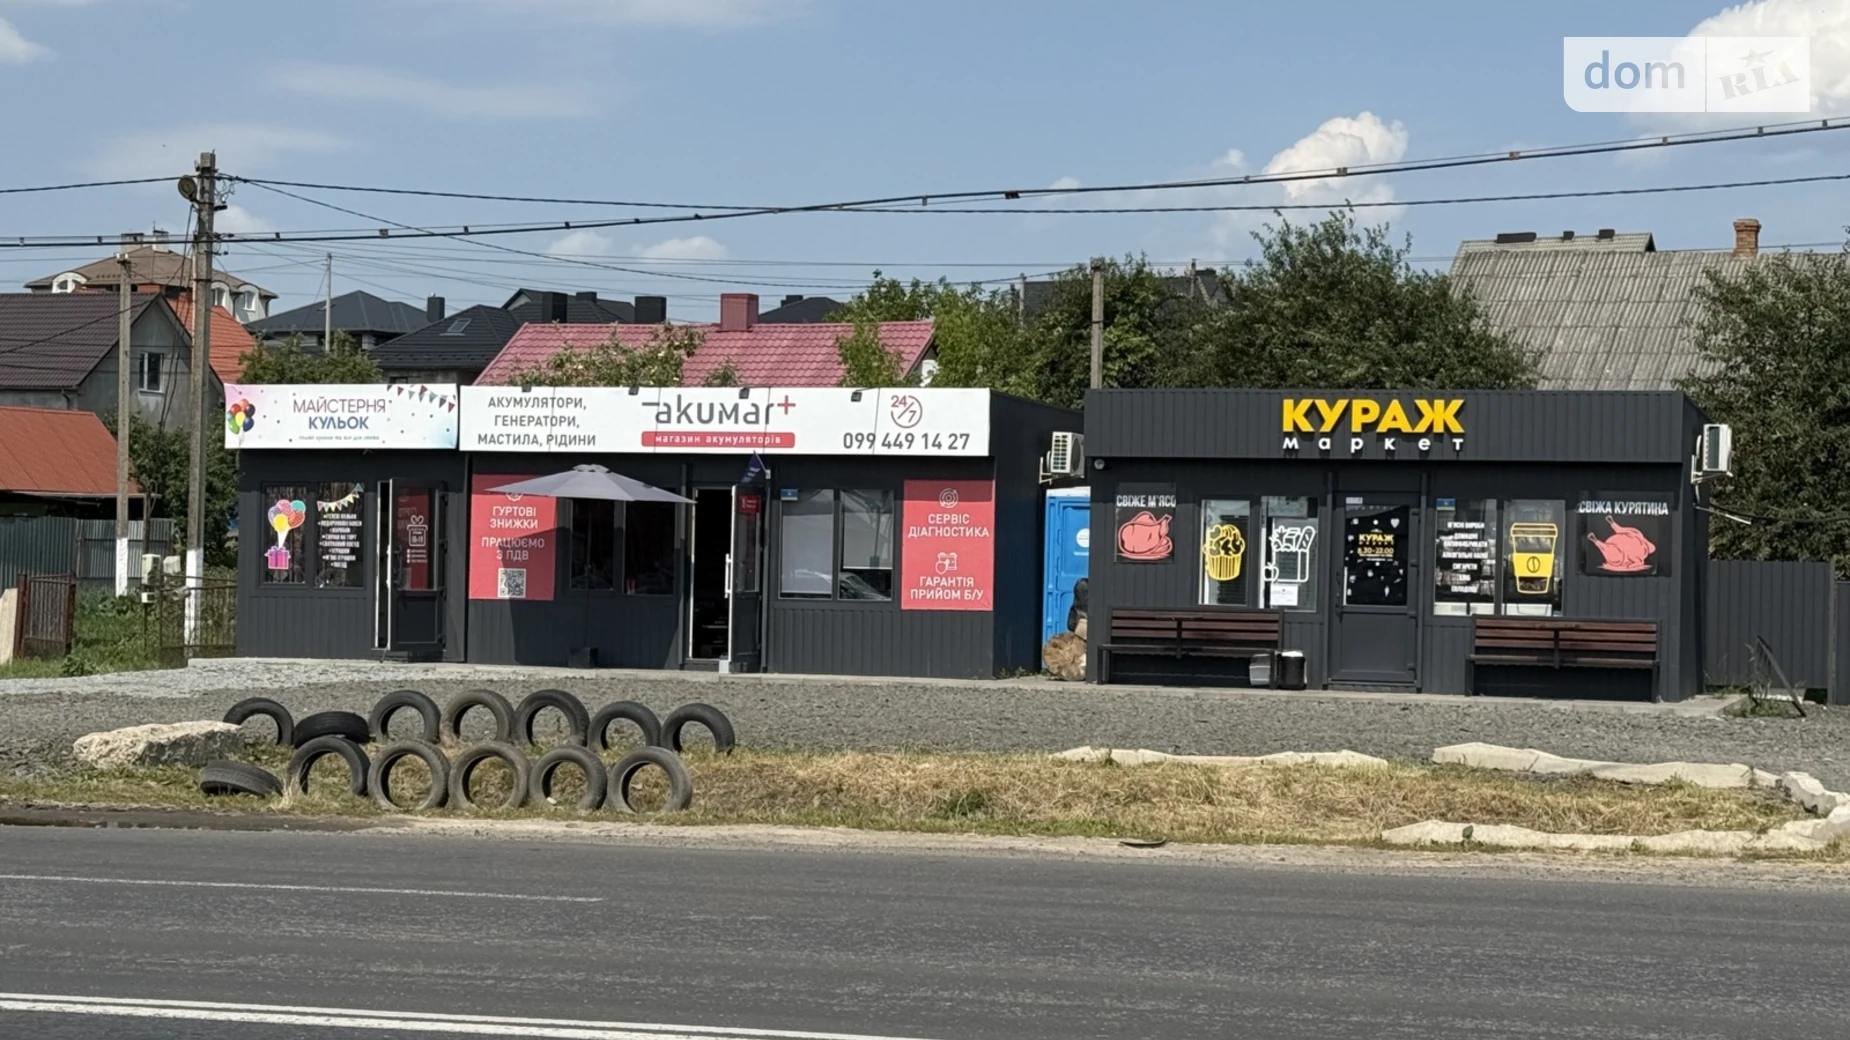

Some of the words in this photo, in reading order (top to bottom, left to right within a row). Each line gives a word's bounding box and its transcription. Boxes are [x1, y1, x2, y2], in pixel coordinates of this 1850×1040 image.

[293, 396, 386, 413] МАЙСТЕРНЯ
[488, 396, 587, 411] АКУМУЛЯТОРИ,
[494, 415, 580, 429] ГЕНЕРАТОРИ,
[1282, 399, 1465, 433] КУРАЖ
[308, 416, 369, 430] КУЛЬОК
[478, 433, 543, 447] МАСТИЛА,
[546, 434, 596, 448] РІДИНИ
[655, 434, 700, 444] магазин
[706, 434, 781, 446] акумуляторів
[843, 433, 875, 449] 099
[881, 433, 914, 450] 449
[921, 433, 942, 450] 14
[947, 433, 970, 450] 27
[1283, 437, 1464, 453] маркет
[1116, 495, 1146, 507] СВІЖЕ
[493, 506, 536, 517] ГУРТОВІ
[1578, 500, 1612, 514] СВІЖА
[1614, 501, 1669, 515] КУРЯТИНА
[490, 519, 538, 529] ЗНИЖКИ
[928, 514, 970, 524] СЕРВІС
[908, 526, 990, 538] ДІАГНОСТИКА
[481, 537, 545, 549] ПРАЦЮЄМО
[506, 550, 529, 561] ПДВ
[920, 576, 974, 587] ГАРАНТІЯ
[911, 588, 961, 600] ПРИЙОМ
[964, 589, 984, 600] Б/У
